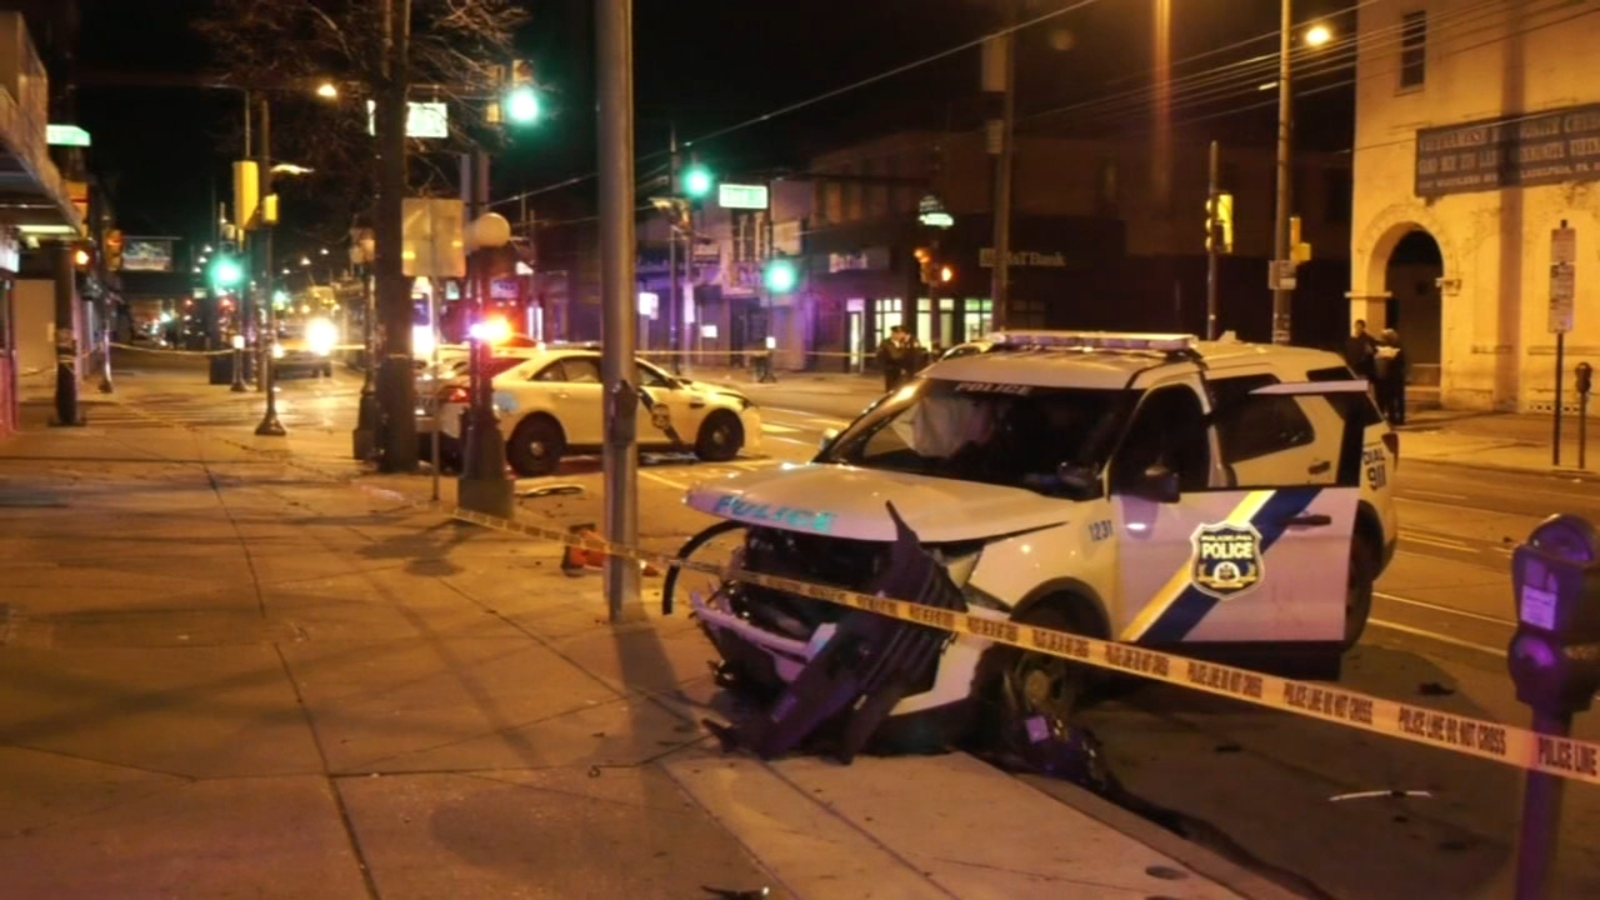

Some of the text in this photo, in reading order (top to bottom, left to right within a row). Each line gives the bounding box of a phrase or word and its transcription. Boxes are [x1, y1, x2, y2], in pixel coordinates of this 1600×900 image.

[954, 382, 1033, 397] POLICE
[713, 494, 838, 535] POLICE
[1202, 542, 1252, 560] POLICE
[1399, 706, 1425, 737] POLICE
[1427, 711, 1445, 741] LINE
[1460, 720, 1476, 748] NOT
[1479, 724, 1506, 756] CROSS
[1539, 736, 1597, 776] POLICE LINE
